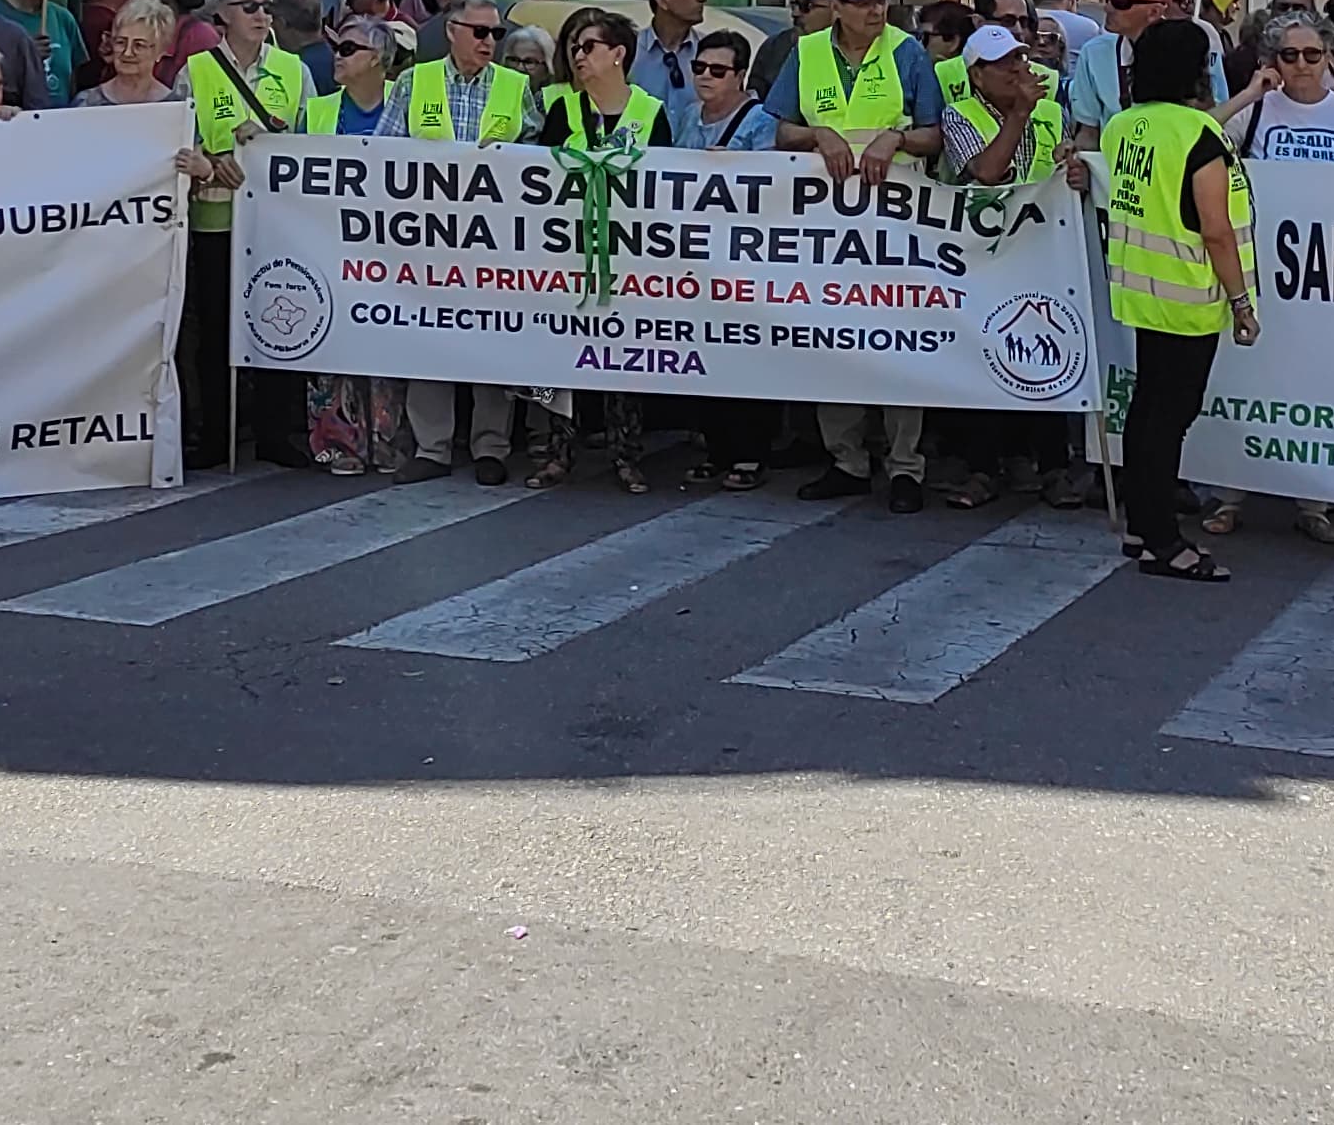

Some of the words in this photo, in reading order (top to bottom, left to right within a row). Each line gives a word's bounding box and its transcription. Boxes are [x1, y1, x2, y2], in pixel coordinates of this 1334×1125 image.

[1276, 132, 1294, 144] LA
[269, 155, 367, 198] PER
[384, 160, 503, 204] UNA
[521, 167, 772, 215] SANITAT
[340, 209, 498, 251] DIGNA
[515, 216, 525, 251] I
[729, 225, 966, 276] RETALLS
[341, 260, 387, 283] NO
[396, 264, 418, 285] A
[427, 265, 466, 288] LA
[476, 268, 699, 301] PRIVATIZACIÓ
[711, 278, 755, 302] DE
[766, 281, 811, 304] LA
[822, 283, 966, 309] SANITAT
[635, 317, 694, 342] PER
[704, 321, 761, 345] LES
[575, 345, 706, 375] ALZIRA
